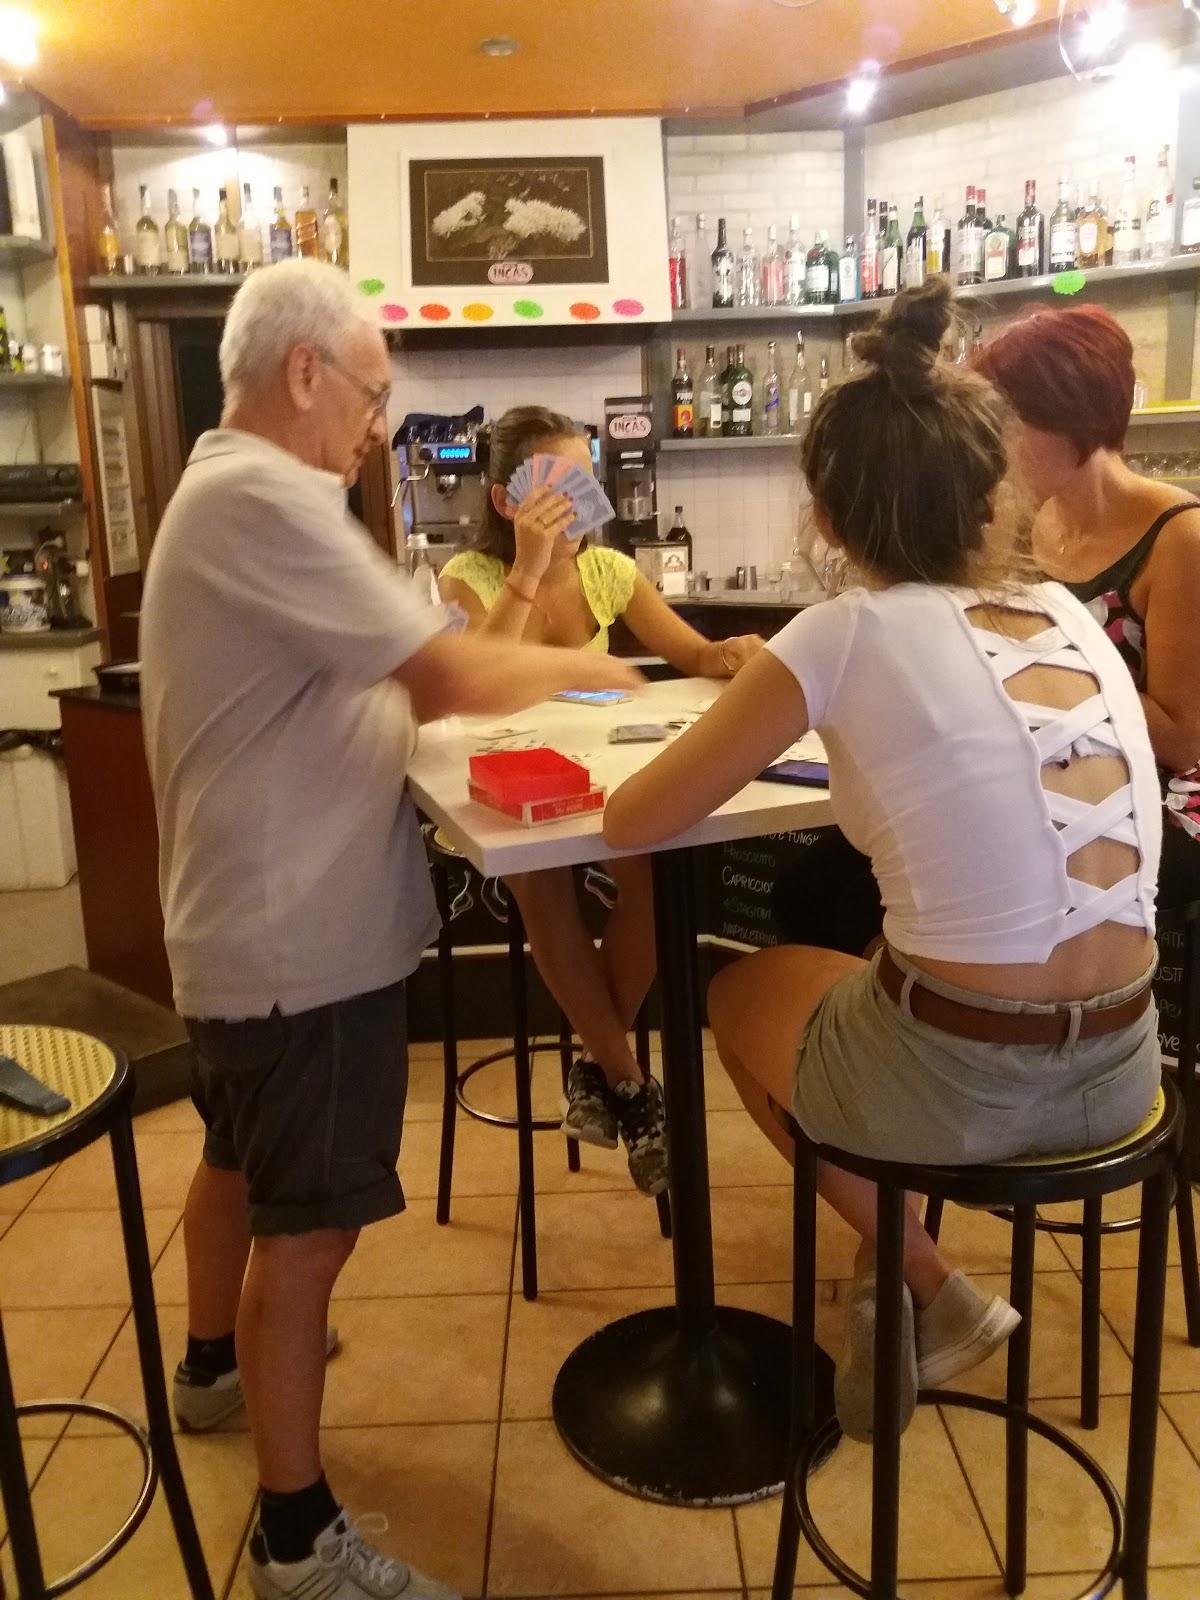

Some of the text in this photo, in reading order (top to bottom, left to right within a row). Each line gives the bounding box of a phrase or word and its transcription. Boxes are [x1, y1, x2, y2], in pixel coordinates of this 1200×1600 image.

[493, 267, 529, 280] INCAS
[614, 420, 647, 433] INCAS
[1157, 1032, 1180, 1052] ove
